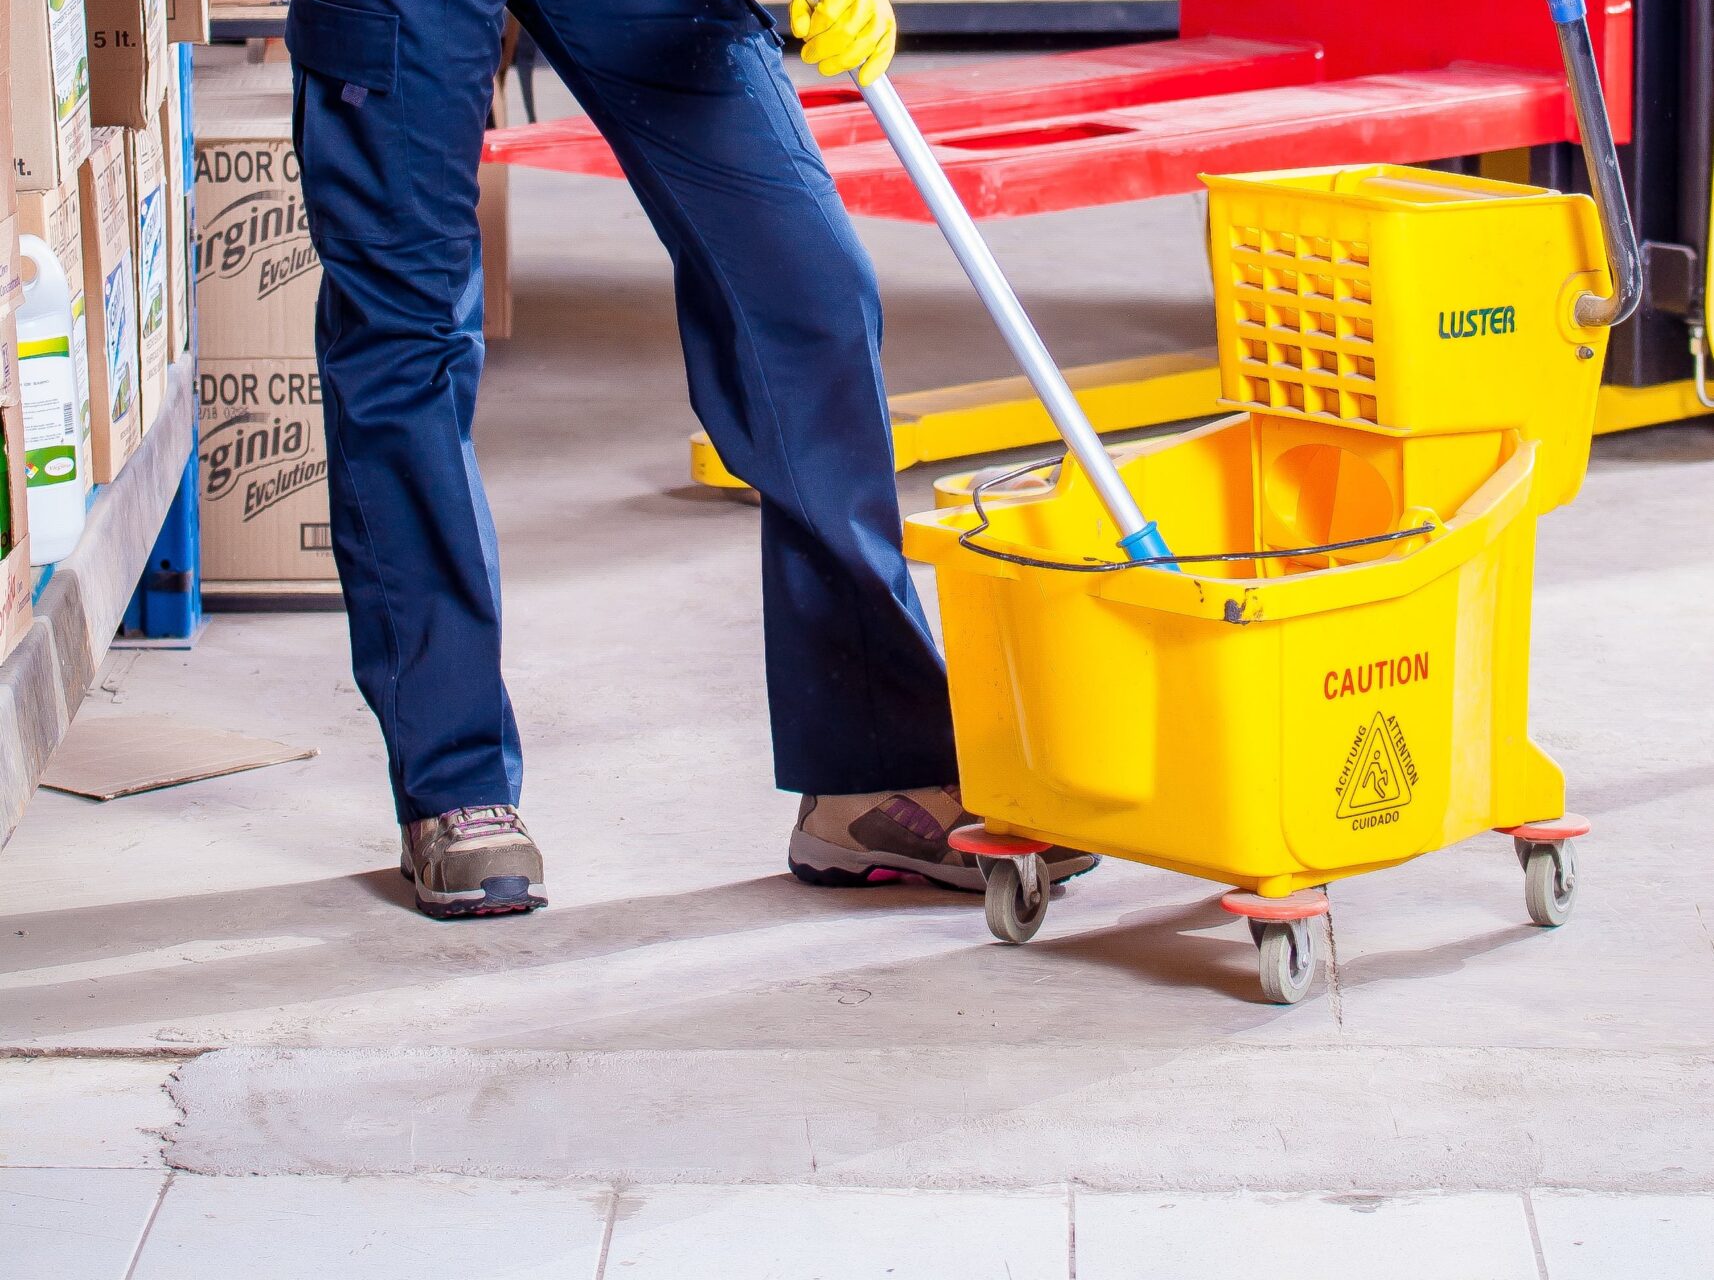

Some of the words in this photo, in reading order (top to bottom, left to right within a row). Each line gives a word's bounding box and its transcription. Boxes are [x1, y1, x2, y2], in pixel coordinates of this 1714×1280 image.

[94, 31, 107, 48] 5
[1438, 305, 1516, 340] LUSTER
[201, 373, 258, 405] DOR
[1323, 651, 1430, 701] CAUTION
[1335, 724, 1367, 797] ACHTUNG
[1386, 715, 1420, 787] ATTENTION
[1351, 810, 1400, 832] CUIDADO
